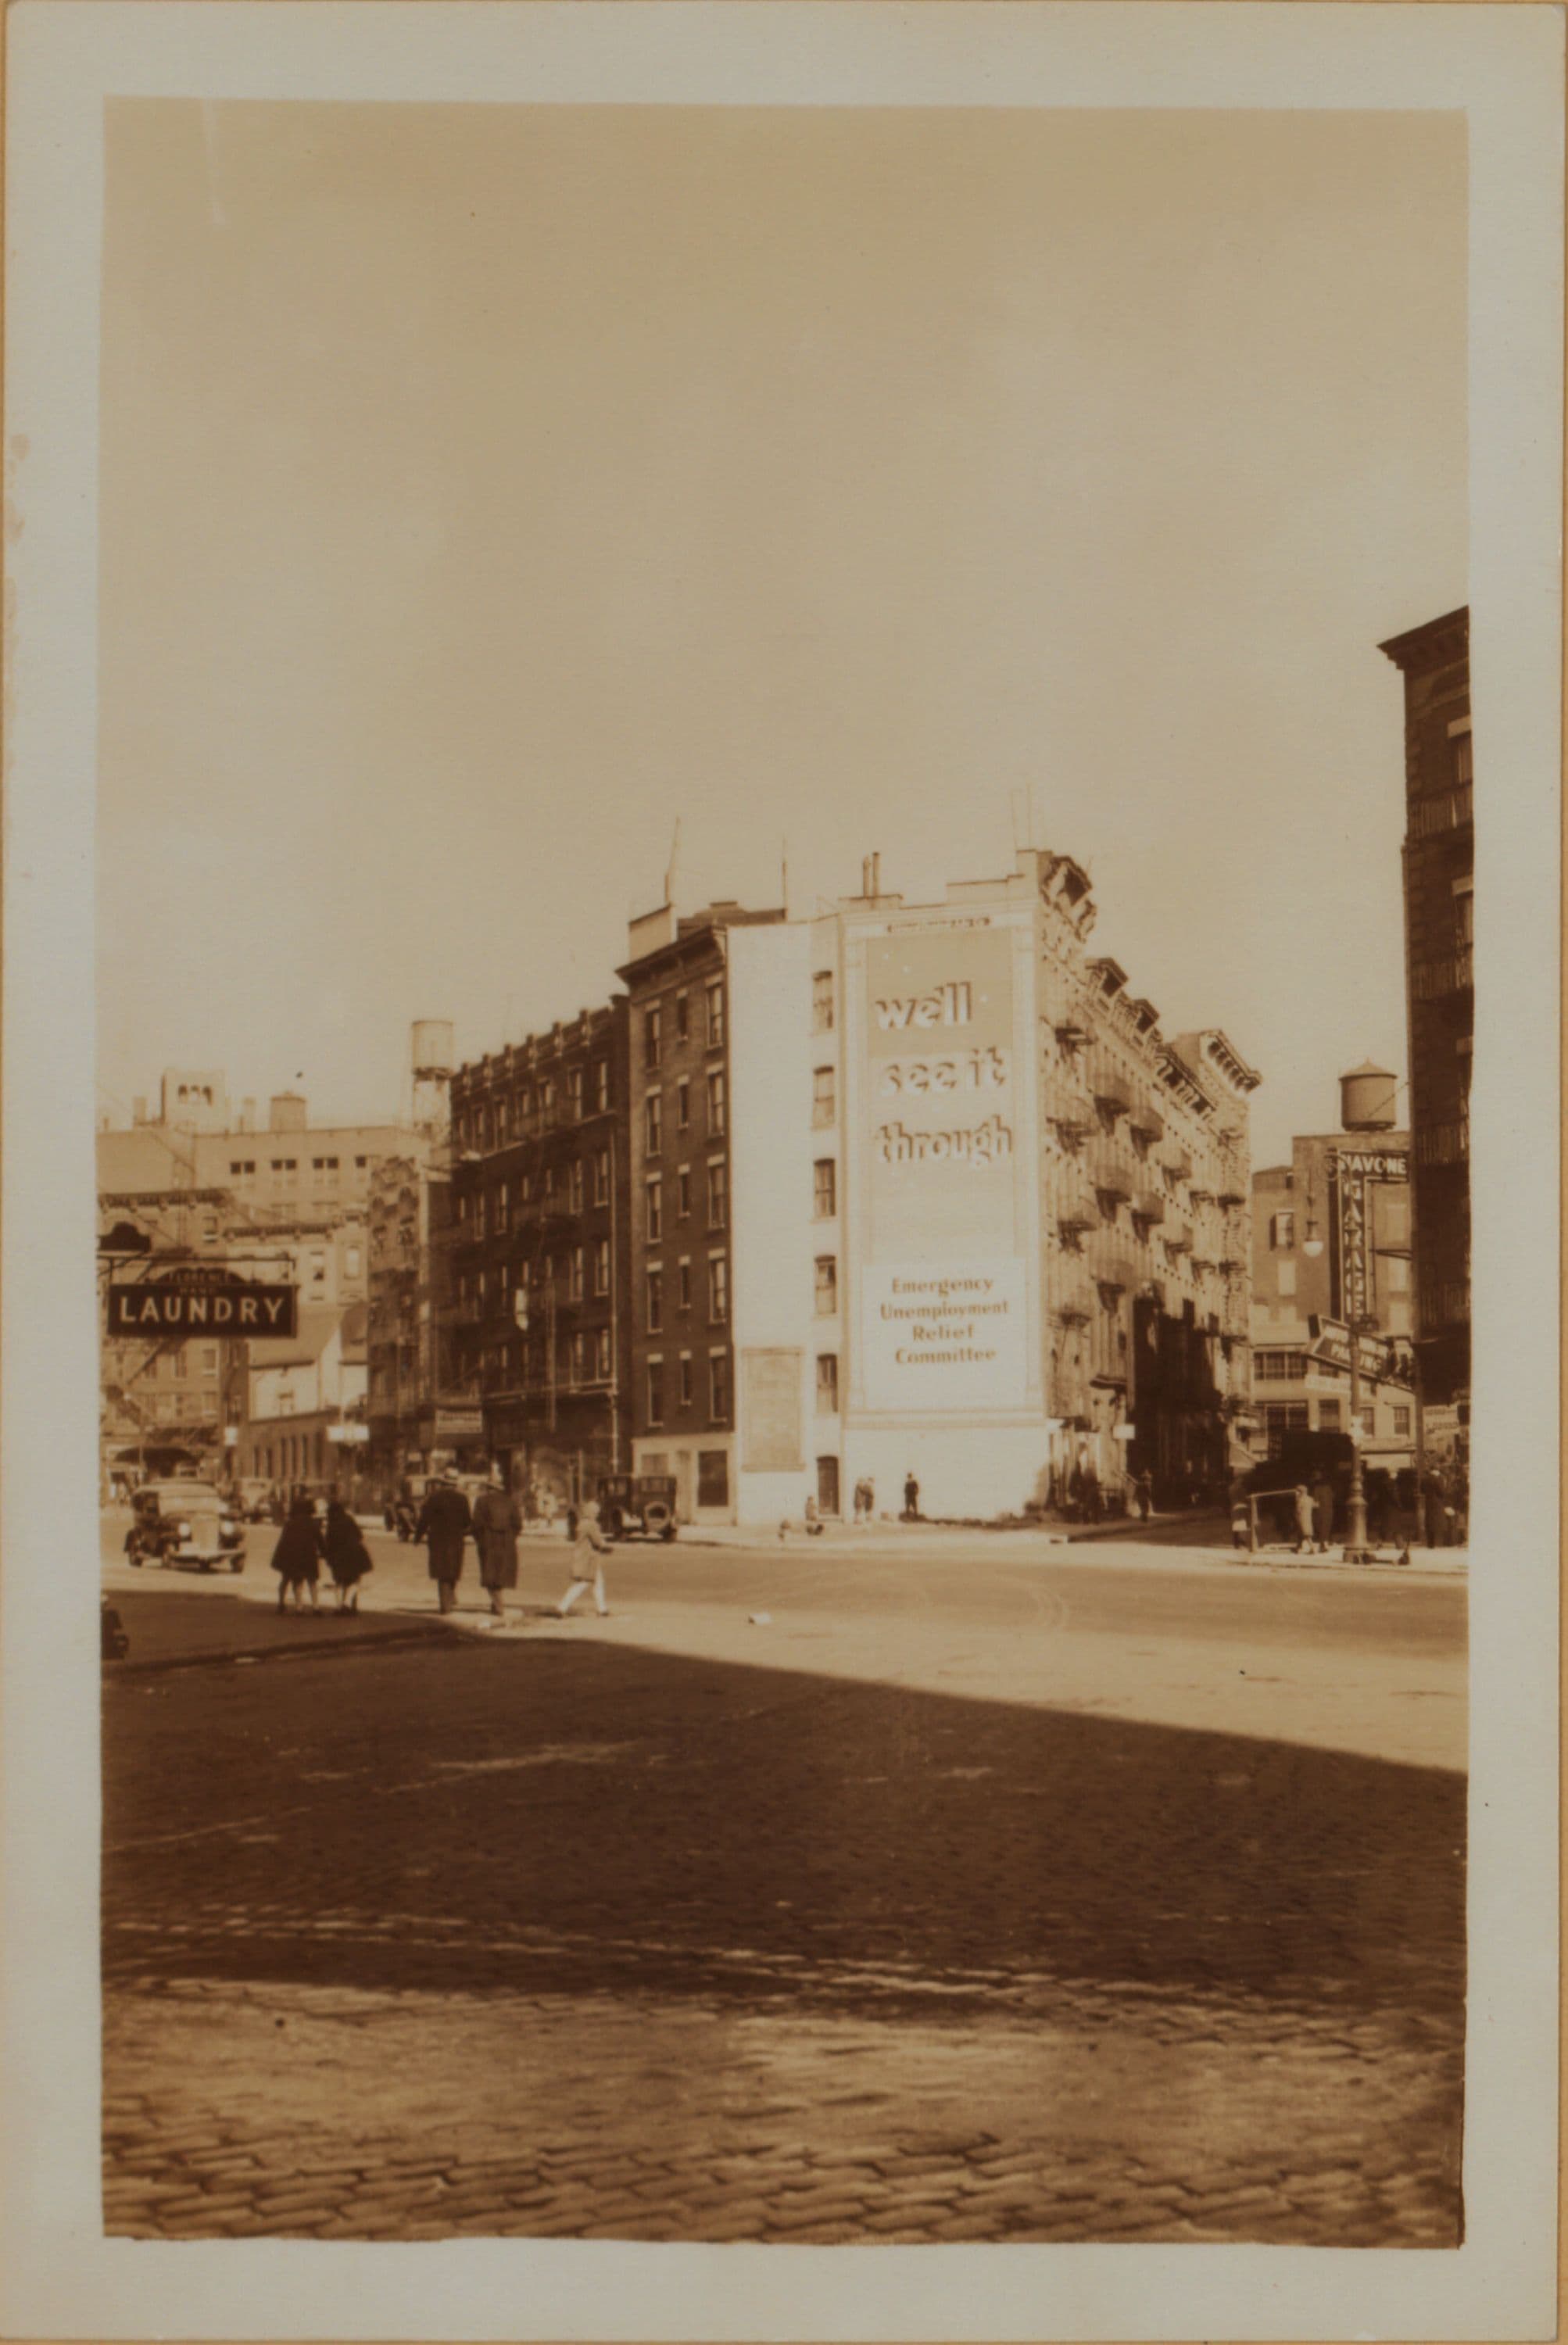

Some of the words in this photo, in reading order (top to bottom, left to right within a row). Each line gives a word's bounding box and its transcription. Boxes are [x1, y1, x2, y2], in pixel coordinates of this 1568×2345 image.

[882, 1062, 957, 1096] see
[968, 1046, 1006, 1089] it
[879, 1112, 1013, 1167] through
[1343, 1179, 1364, 1322] GARAGE
[892, 1278, 993, 1298] Emergency
[120, 1295, 284, 1324] LAUNDRY
[880, 1301, 1008, 1320] Unemployment
[911, 1324, 976, 1341] Relief
[895, 1347, 997, 1365] Committee
